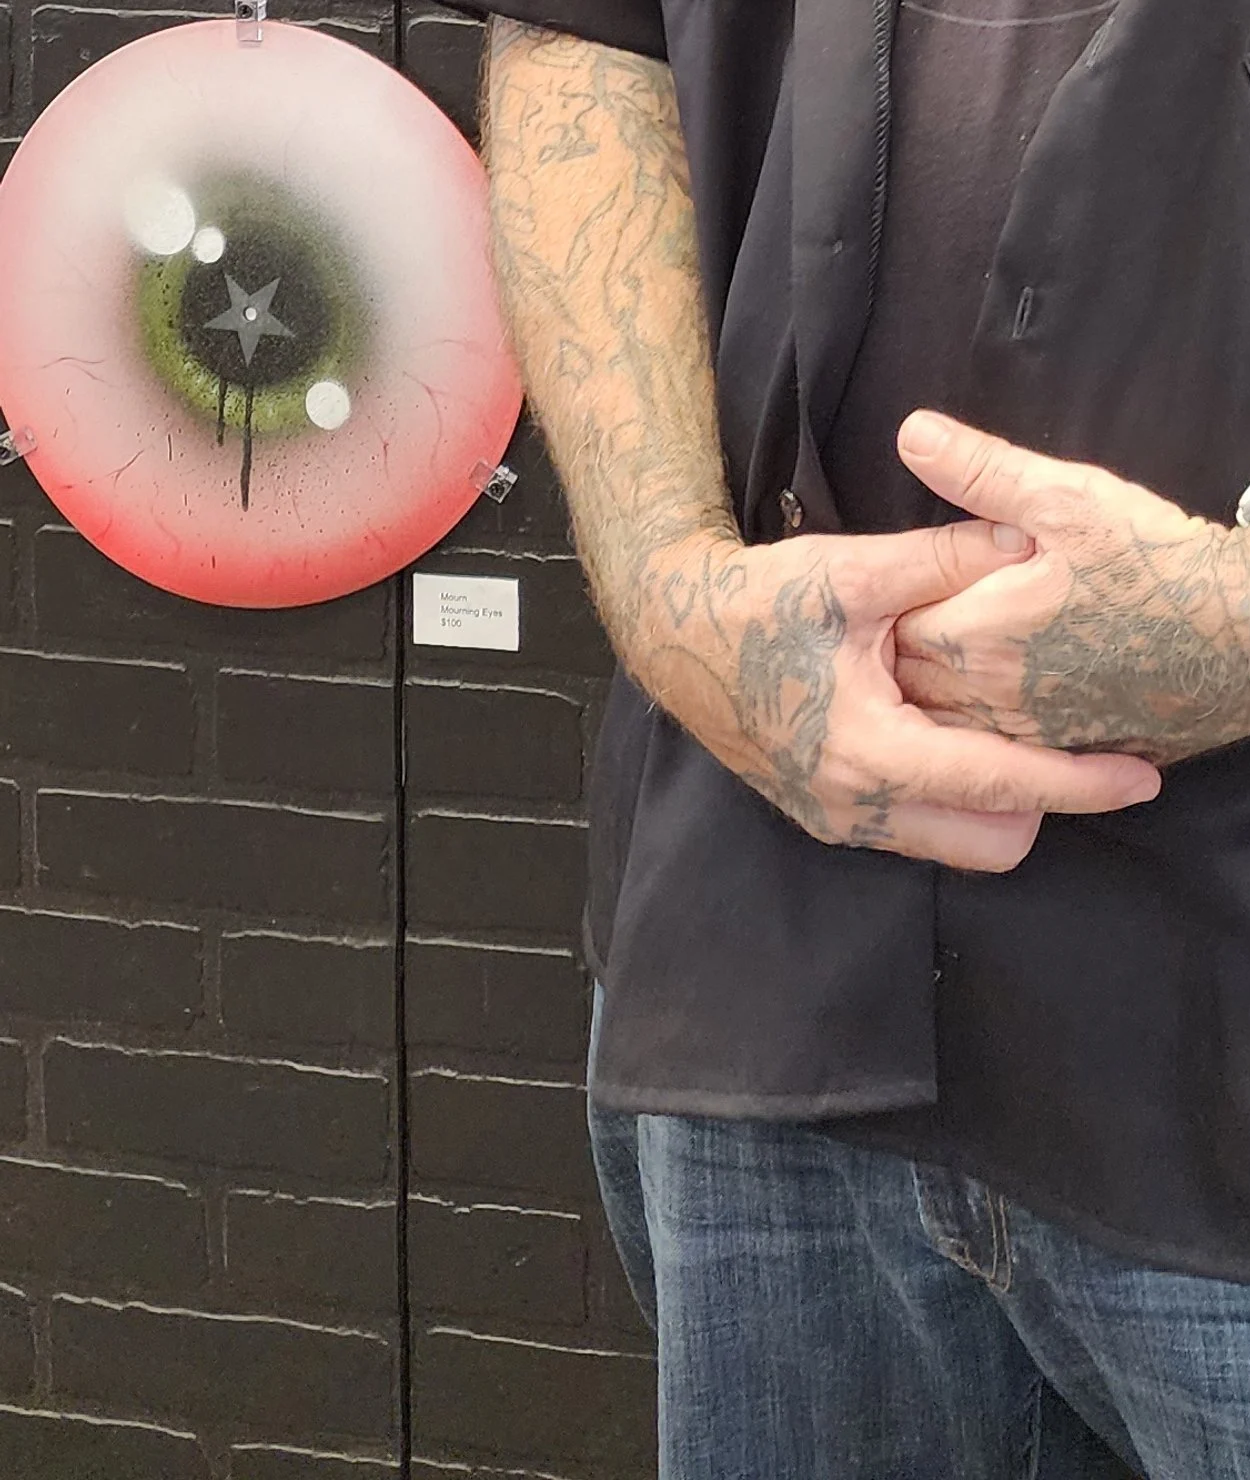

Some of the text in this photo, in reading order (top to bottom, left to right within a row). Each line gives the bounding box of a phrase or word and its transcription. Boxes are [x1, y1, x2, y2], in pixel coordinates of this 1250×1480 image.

[440, 592, 468, 602] Mourn
[440, 605, 503, 619] Mourning Eyes
[440, 618, 462, 628] $100
